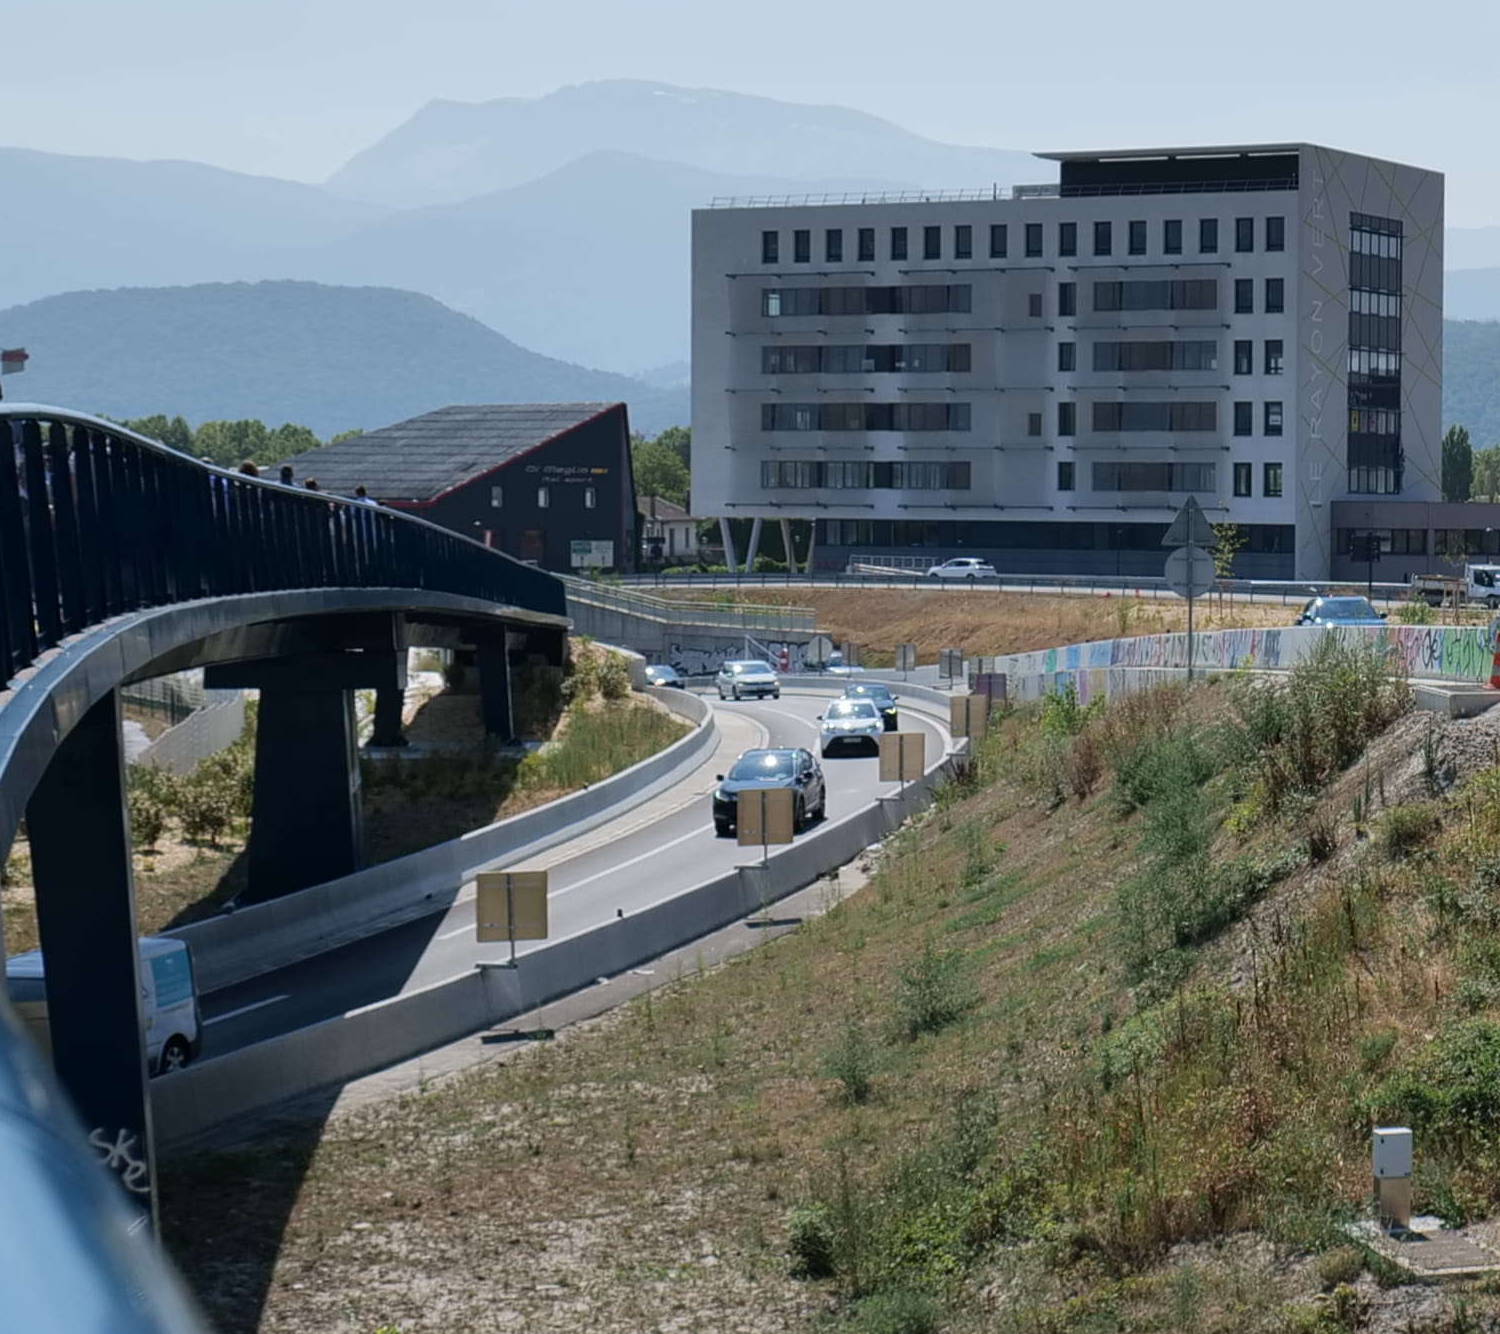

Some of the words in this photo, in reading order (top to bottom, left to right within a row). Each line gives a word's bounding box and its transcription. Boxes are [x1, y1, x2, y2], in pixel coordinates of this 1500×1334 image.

[1310, 169, 1325, 278] VERT
[1309, 298, 1324, 440] RAYON
[1309, 461, 1324, 509] LE
